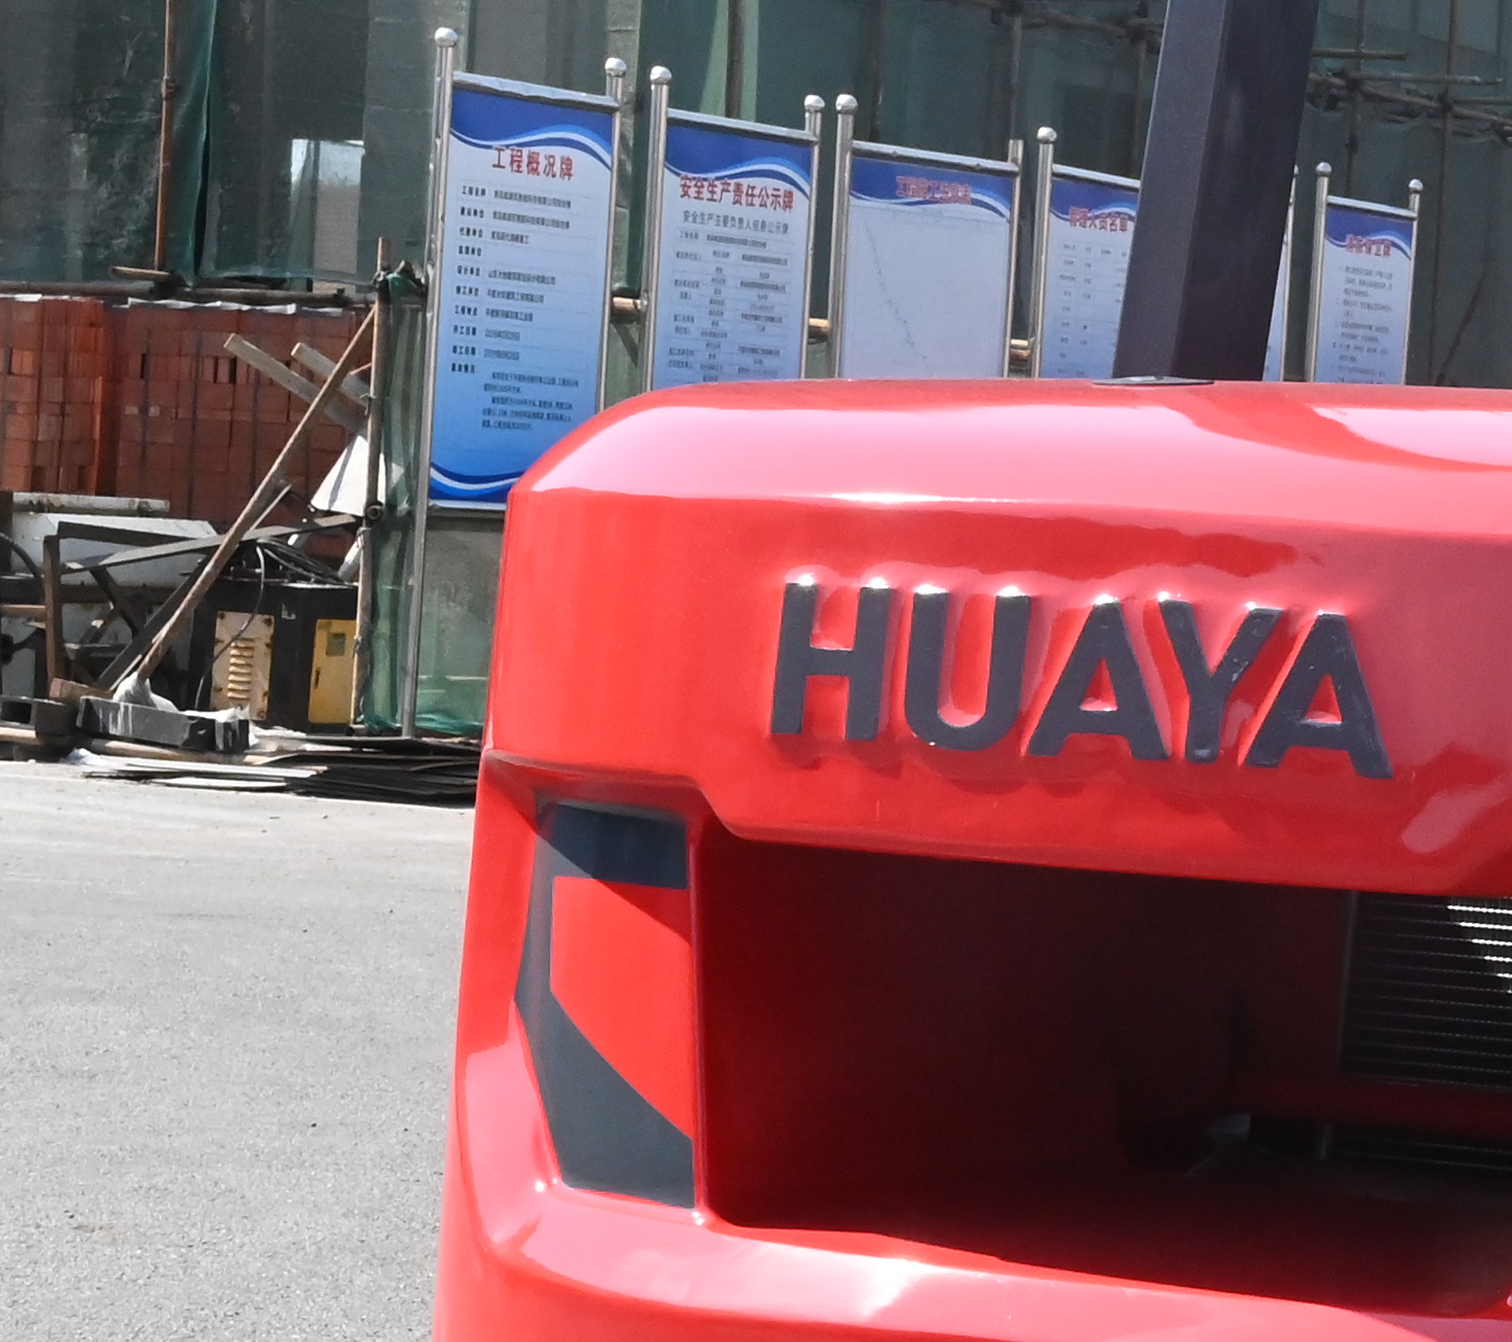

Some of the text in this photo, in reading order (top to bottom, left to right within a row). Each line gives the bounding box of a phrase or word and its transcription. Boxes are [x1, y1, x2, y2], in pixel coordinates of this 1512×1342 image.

[492, 146, 574, 181] 工程概况牌
[680, 174, 794, 213] 安全生产责任公示牌
[769, 578, 1393, 779] HUAYA
